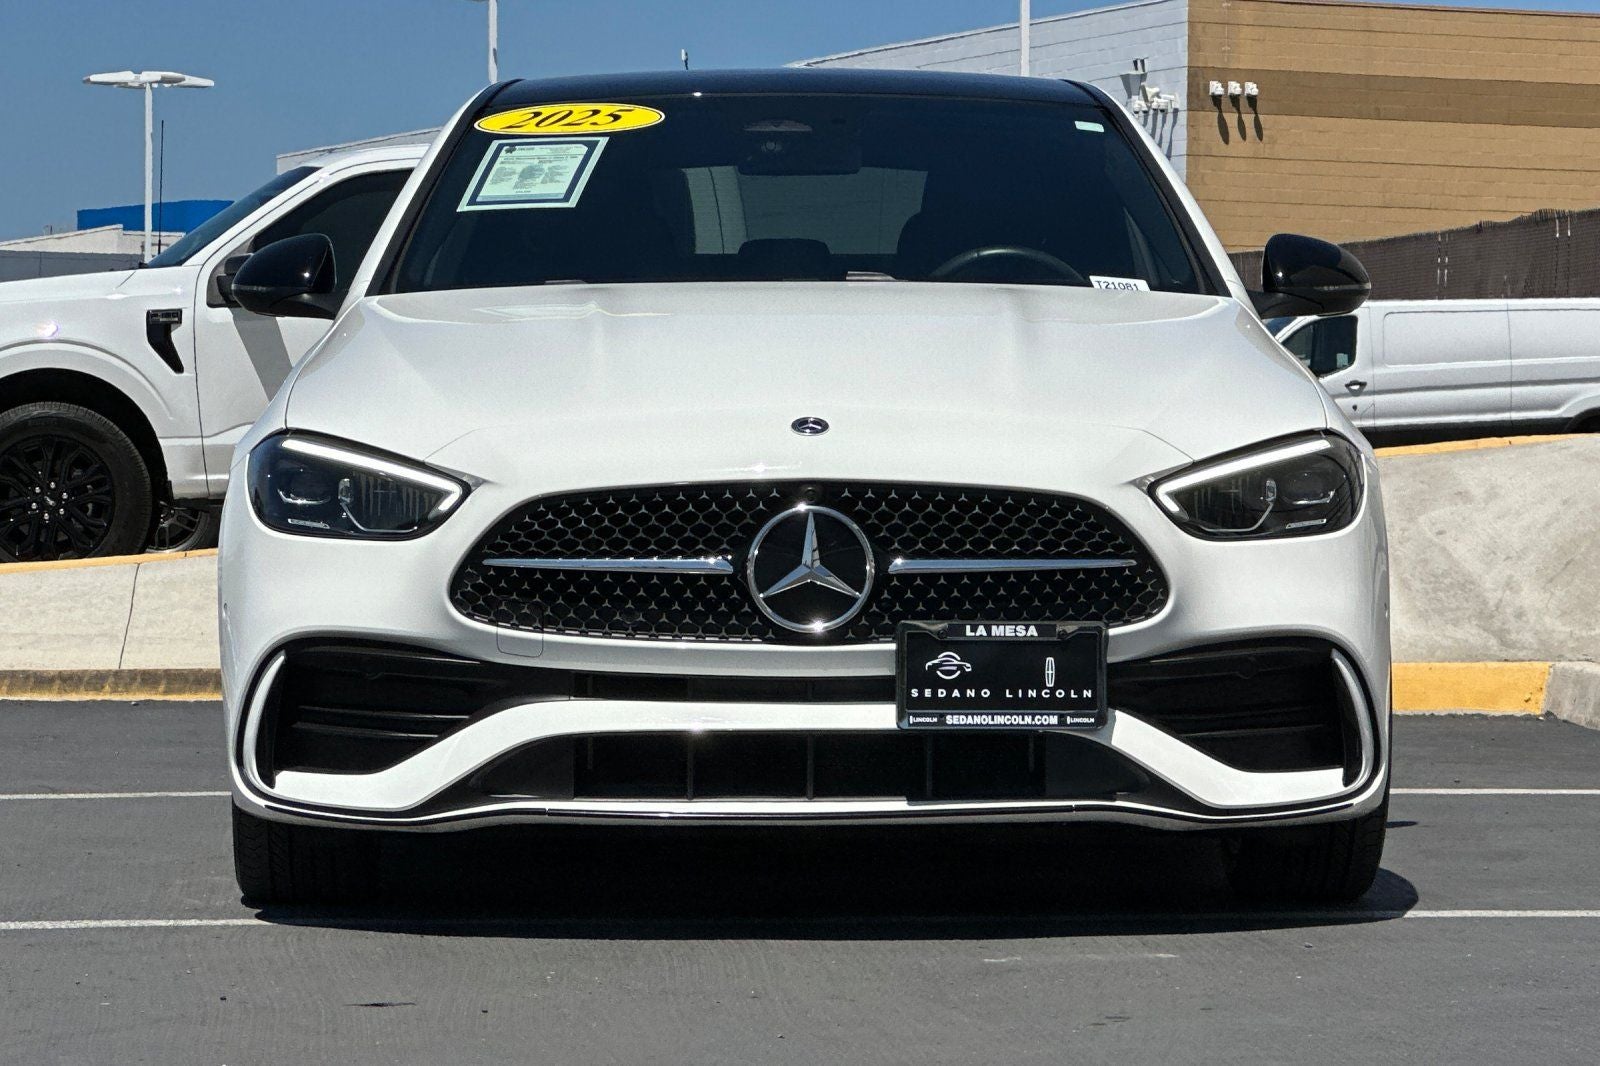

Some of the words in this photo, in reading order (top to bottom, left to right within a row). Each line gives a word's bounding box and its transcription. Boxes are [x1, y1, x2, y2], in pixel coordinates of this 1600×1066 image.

[500, 109, 636, 130] 2025
[1095, 280, 1139, 291] T21081
[965, 625, 988, 637] LA
[991, 625, 1039, 637] MESA
[911, 688, 991, 698] SEDANO
[1005, 689, 1092, 698] LINCOLN
[945, 715, 1058, 725] SEDANOLINCOLN.COM
